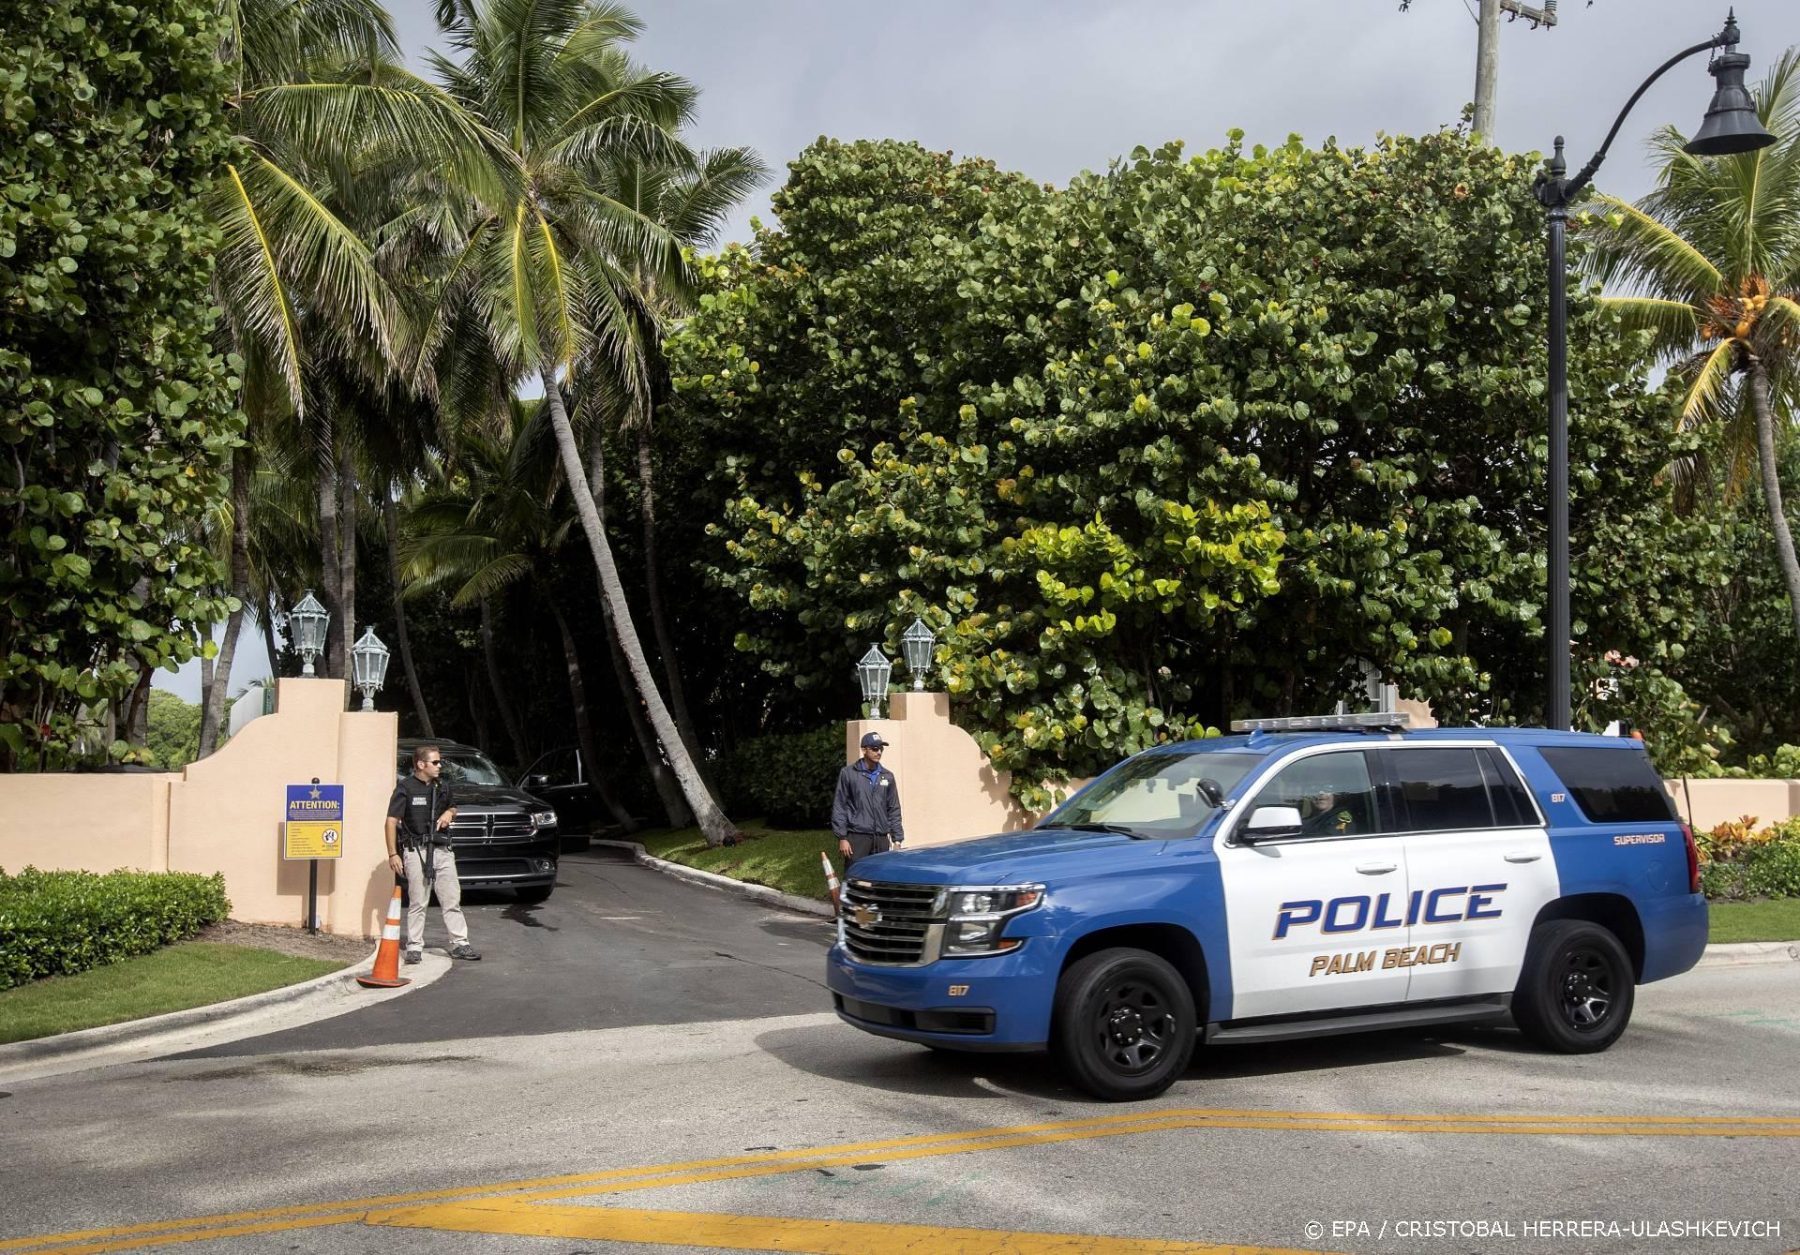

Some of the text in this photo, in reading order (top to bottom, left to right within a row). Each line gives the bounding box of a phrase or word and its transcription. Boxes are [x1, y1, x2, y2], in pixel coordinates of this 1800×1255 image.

[1552, 794, 1566, 802] 817
[290, 800, 340, 809] ATTENTION:
[1614, 834, 1666, 846] SUPERVISOR
[1272, 883, 1508, 940] POLICE
[1309, 942, 1462, 977] PALM BEACH
[948, 985, 970, 996] 817
